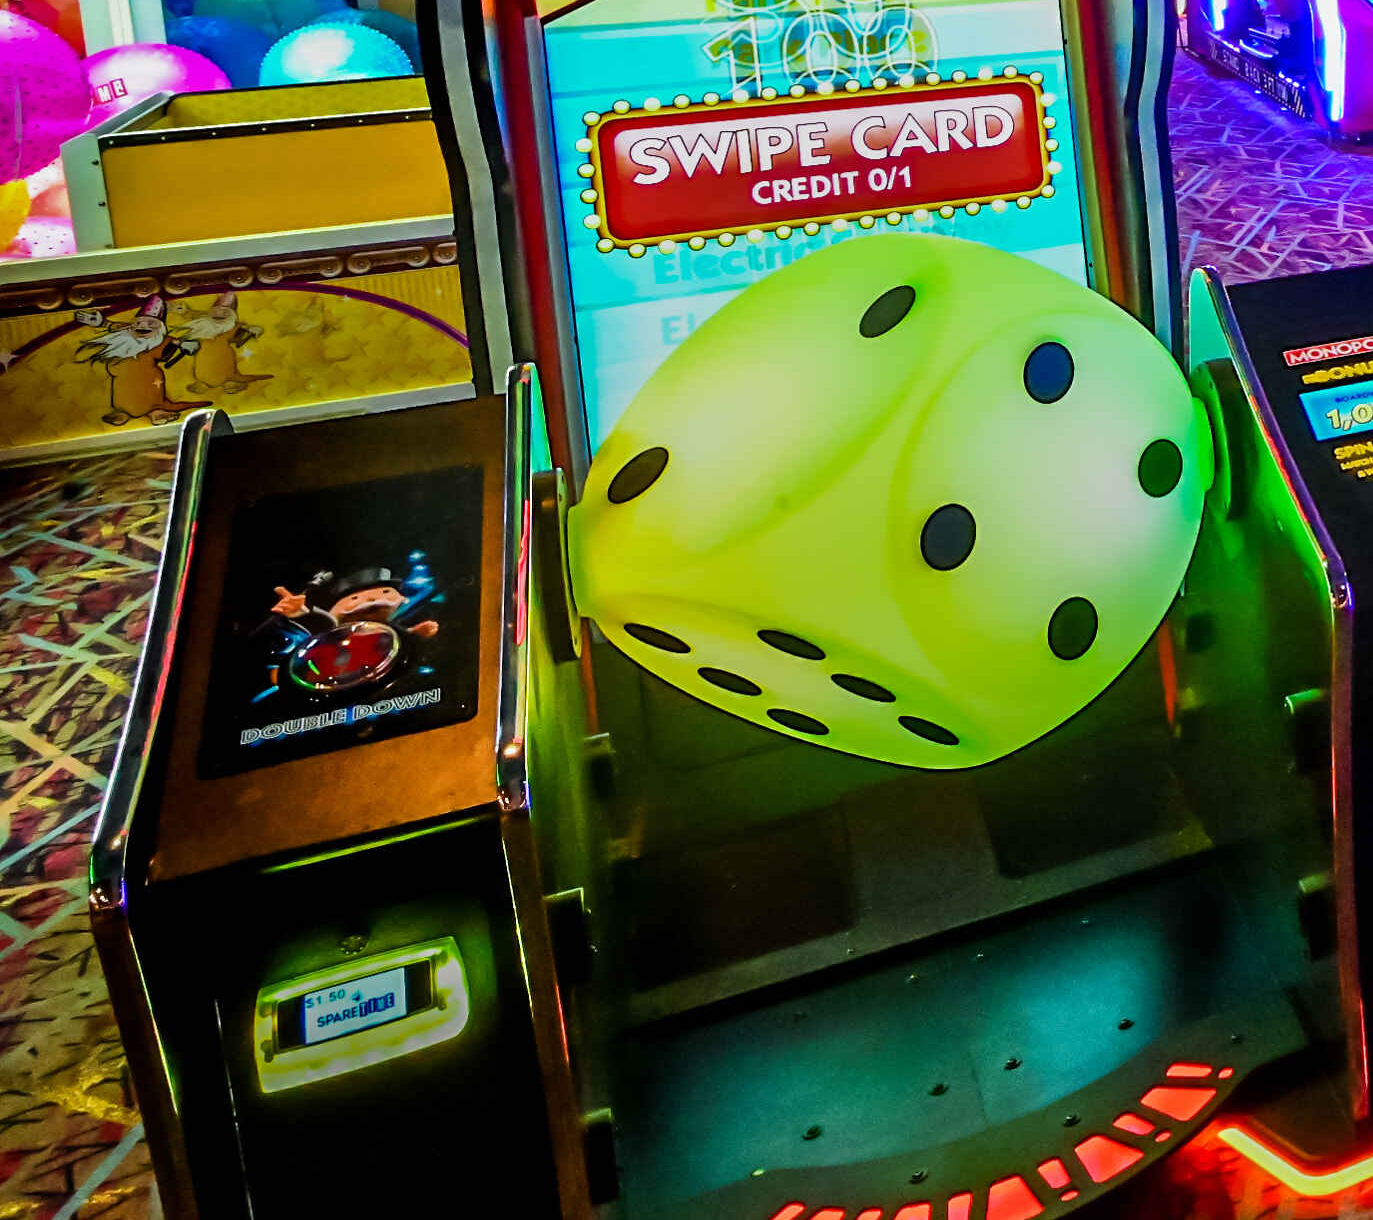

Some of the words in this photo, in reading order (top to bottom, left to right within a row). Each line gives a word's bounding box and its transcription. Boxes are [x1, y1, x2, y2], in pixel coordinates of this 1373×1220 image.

[628, 121, 832, 186] SWIPE
[851, 105, 1016, 161] CARD
[751, 172, 858, 206] CREDIT
[867, 165, 913, 193] 0/1
[240, 707, 347, 746] DOUBLE
[351, 687, 442, 721] DOWN
